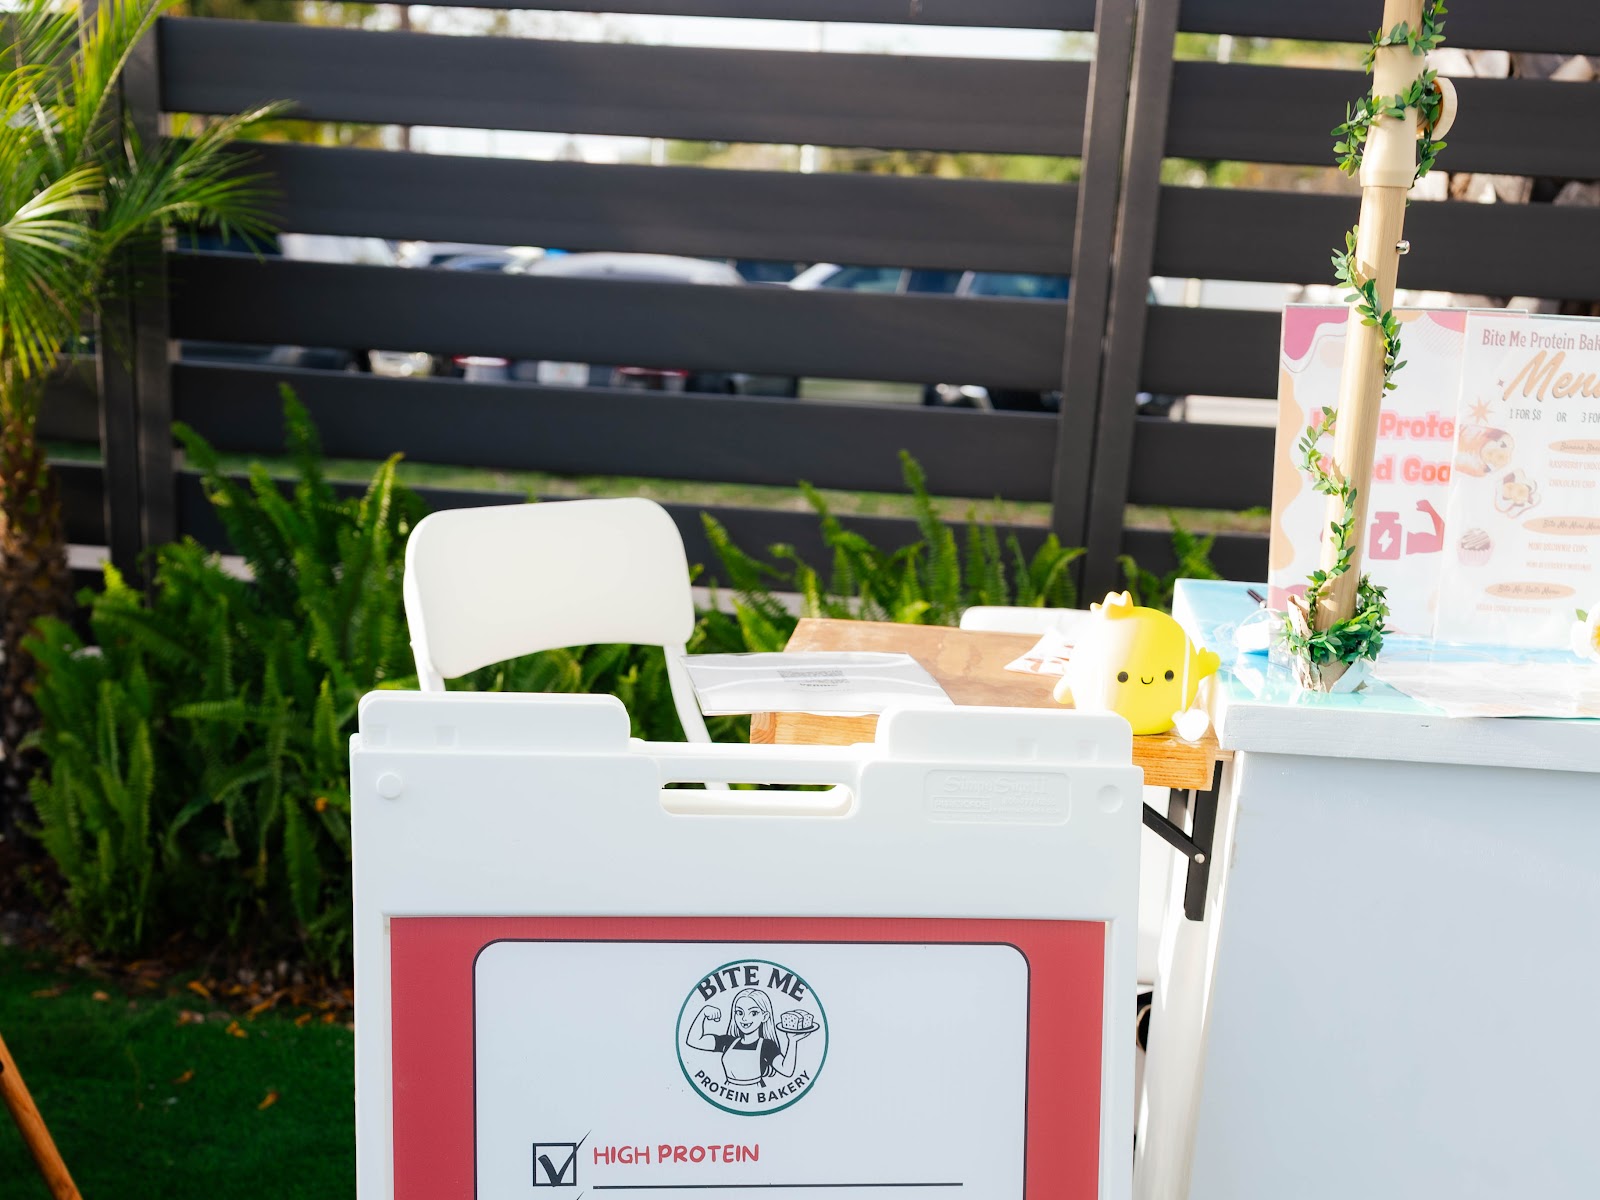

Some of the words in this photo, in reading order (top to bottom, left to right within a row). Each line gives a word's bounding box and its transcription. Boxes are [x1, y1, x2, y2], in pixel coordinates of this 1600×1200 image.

[1482, 328, 1506, 347] Bite
[1509, 330, 1527, 347] Me
[1530, 331, 1575, 350] Protein
[1379, 410, 1456, 441] Prote
[1515, 409, 1530, 420] FOR
[1556, 412, 1567, 423] OR
[1581, 412, 1587, 423] 3
[697, 965, 760, 1002] BITE
[767, 967, 809, 1002] ME
[694, 1069, 750, 1104] PROTEIN
[757, 1069, 811, 1104] BAKERY
[593, 1145, 651, 1165] HIGH
[657, 1144, 759, 1164] PROTEIN
